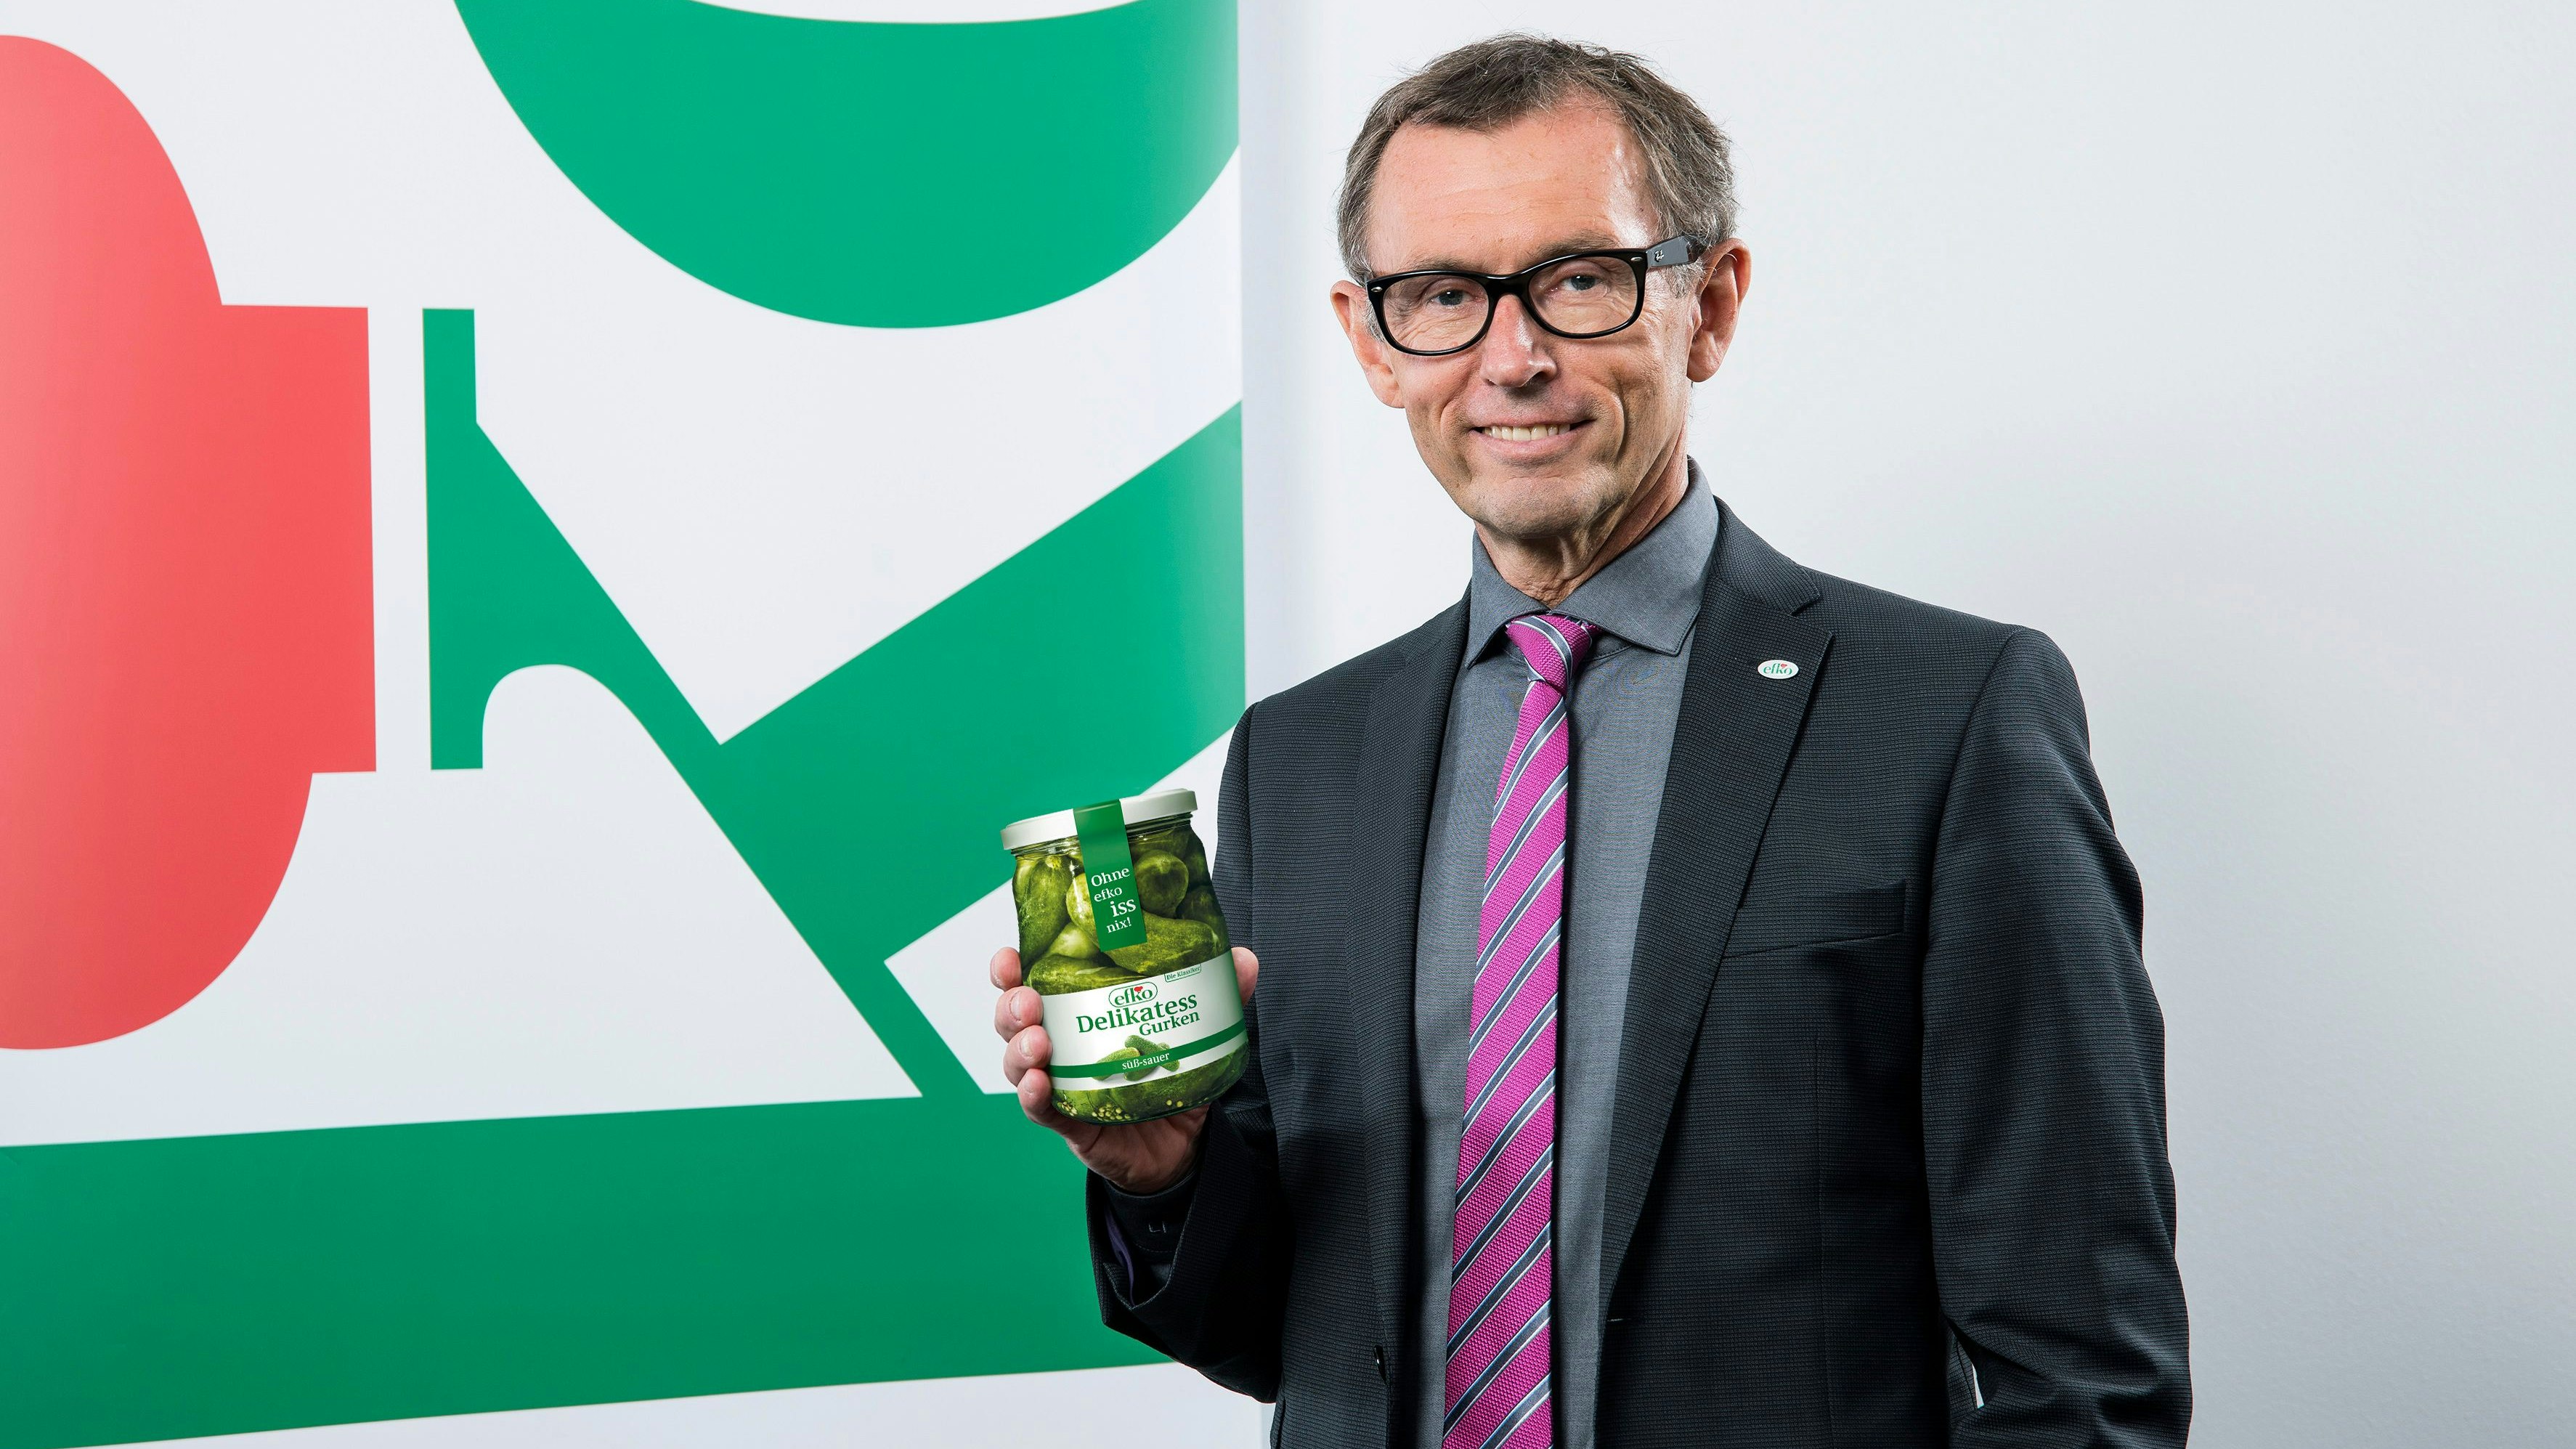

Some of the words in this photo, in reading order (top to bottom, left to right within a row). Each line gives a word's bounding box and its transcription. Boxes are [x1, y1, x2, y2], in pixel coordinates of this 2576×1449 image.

[1763, 662, 1792, 675] efko
[1091, 868, 1131, 887] Ohne
[1094, 887, 1123, 902] efko
[1110, 898, 1137, 917] iss
[1106, 917, 1132, 933] nix!
[1177, 967, 1200, 978] Klassiker
[1114, 987, 1153, 1006] efko
[1076, 994, 1198, 1033] Delikatess
[1139, 1011, 1200, 1036] Gurken
[1122, 1052, 1170, 1070] süß-sauer
